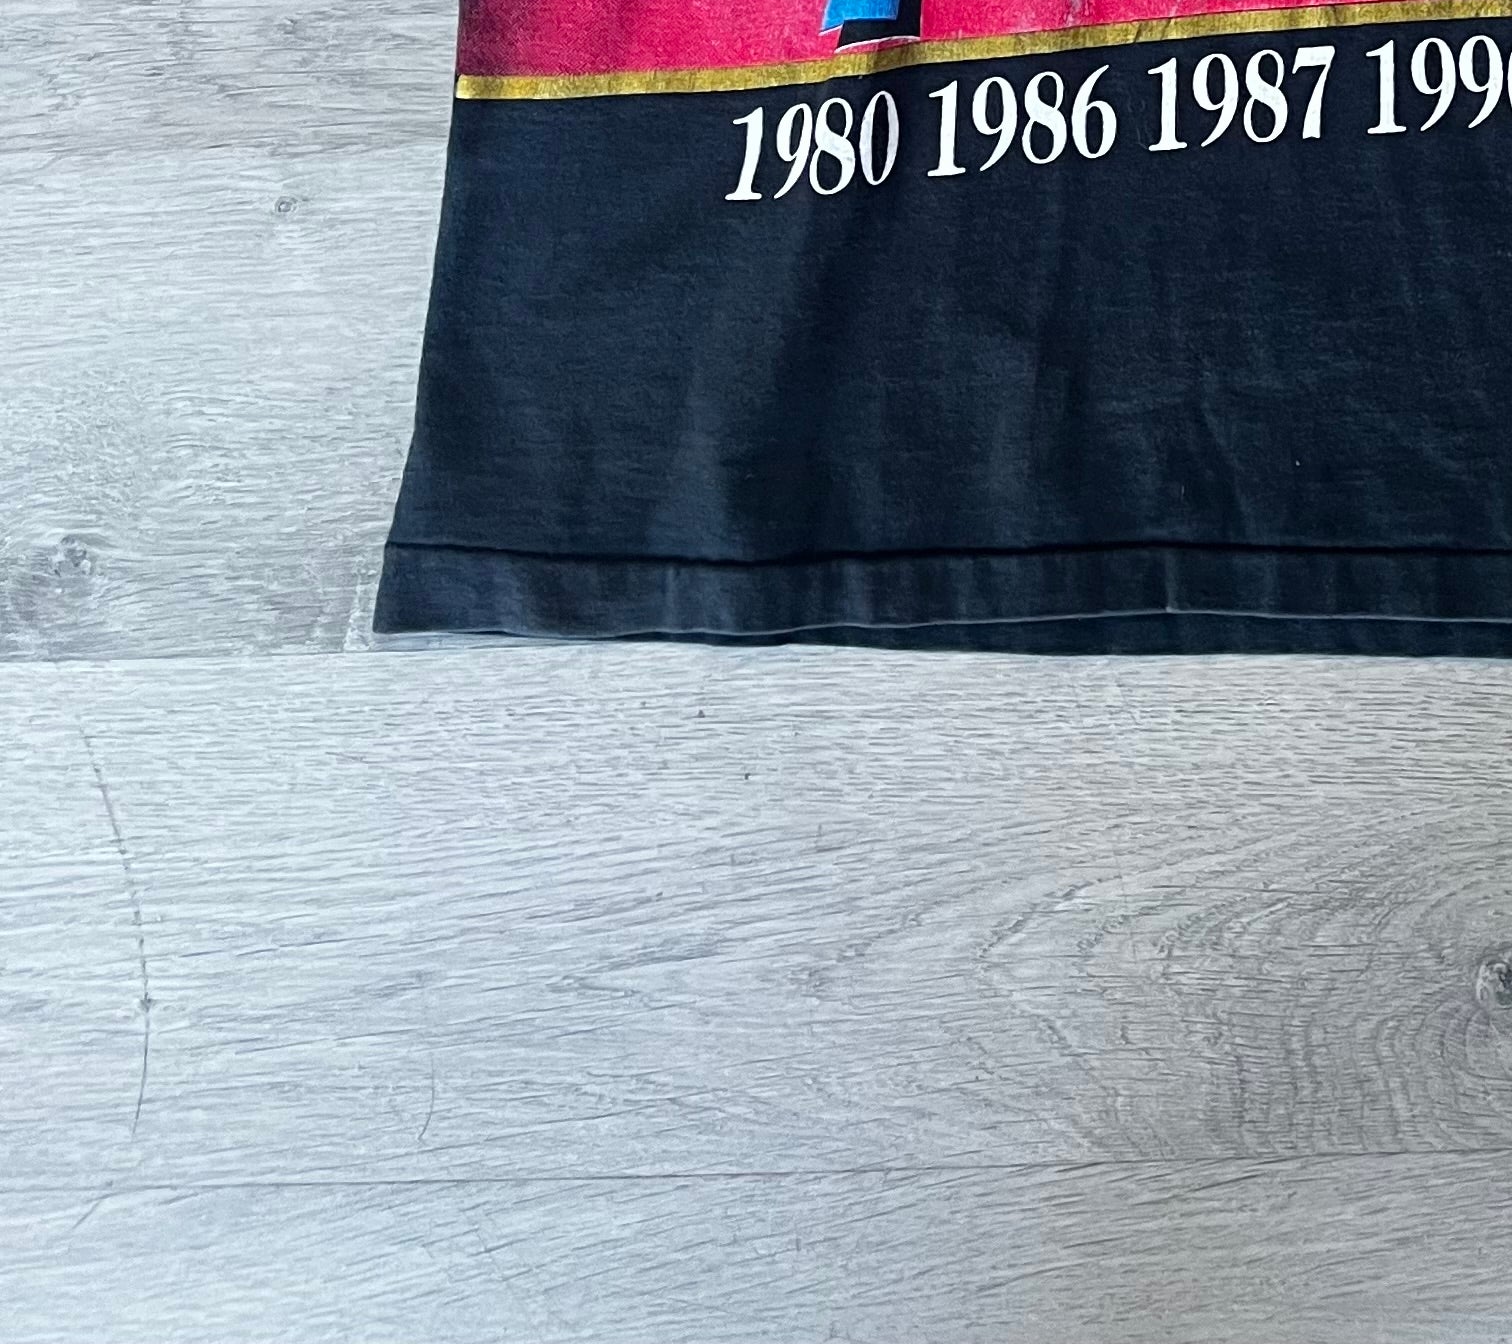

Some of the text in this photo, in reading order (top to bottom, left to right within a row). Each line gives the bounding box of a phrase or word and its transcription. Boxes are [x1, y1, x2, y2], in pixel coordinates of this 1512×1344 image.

[724, 89, 900, 201] 1980
[927, 64, 1117, 178] 1986
[1147, 45, 1336, 154] 1987
